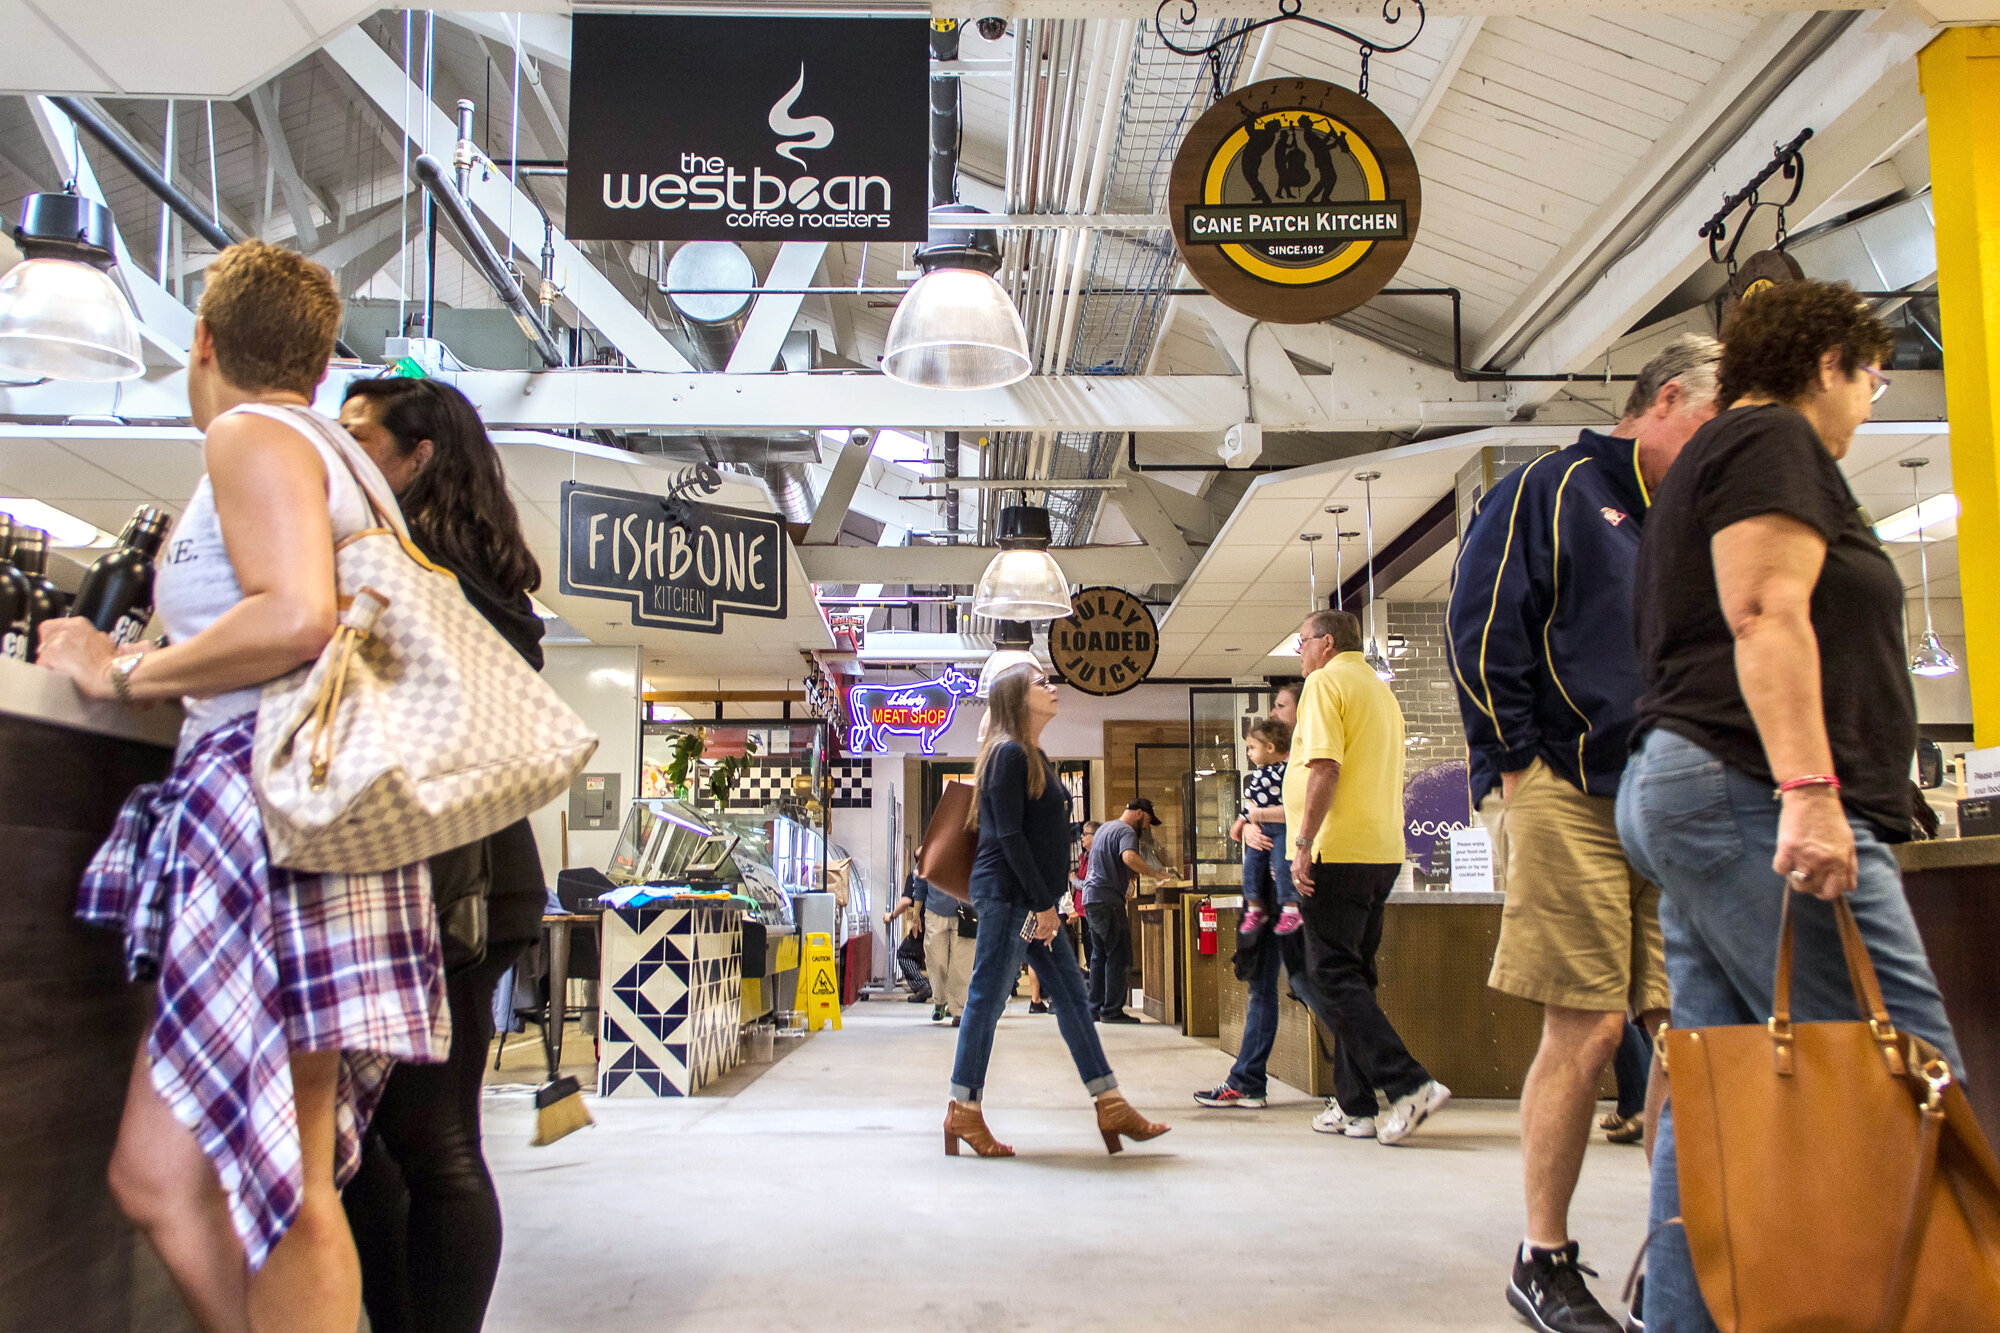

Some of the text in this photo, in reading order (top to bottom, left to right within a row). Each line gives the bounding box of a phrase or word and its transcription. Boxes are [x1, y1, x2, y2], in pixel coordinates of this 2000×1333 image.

[681, 152, 724, 174] the
[726, 211, 891, 228] coffee roasters
[1192, 212, 1398, 234] CANE PATCH KITCHEN
[167, 538, 198, 565] E.
[589, 512, 766, 593] FISHBONE
[654, 584, 705, 615] KITCHEN
[1060, 631, 1151, 651] LOADED
[1065, 655, 1141, 686] JUICE
[871, 709, 946, 724] MEAT SHOP
[1974, 772, 1992, 780] Please
